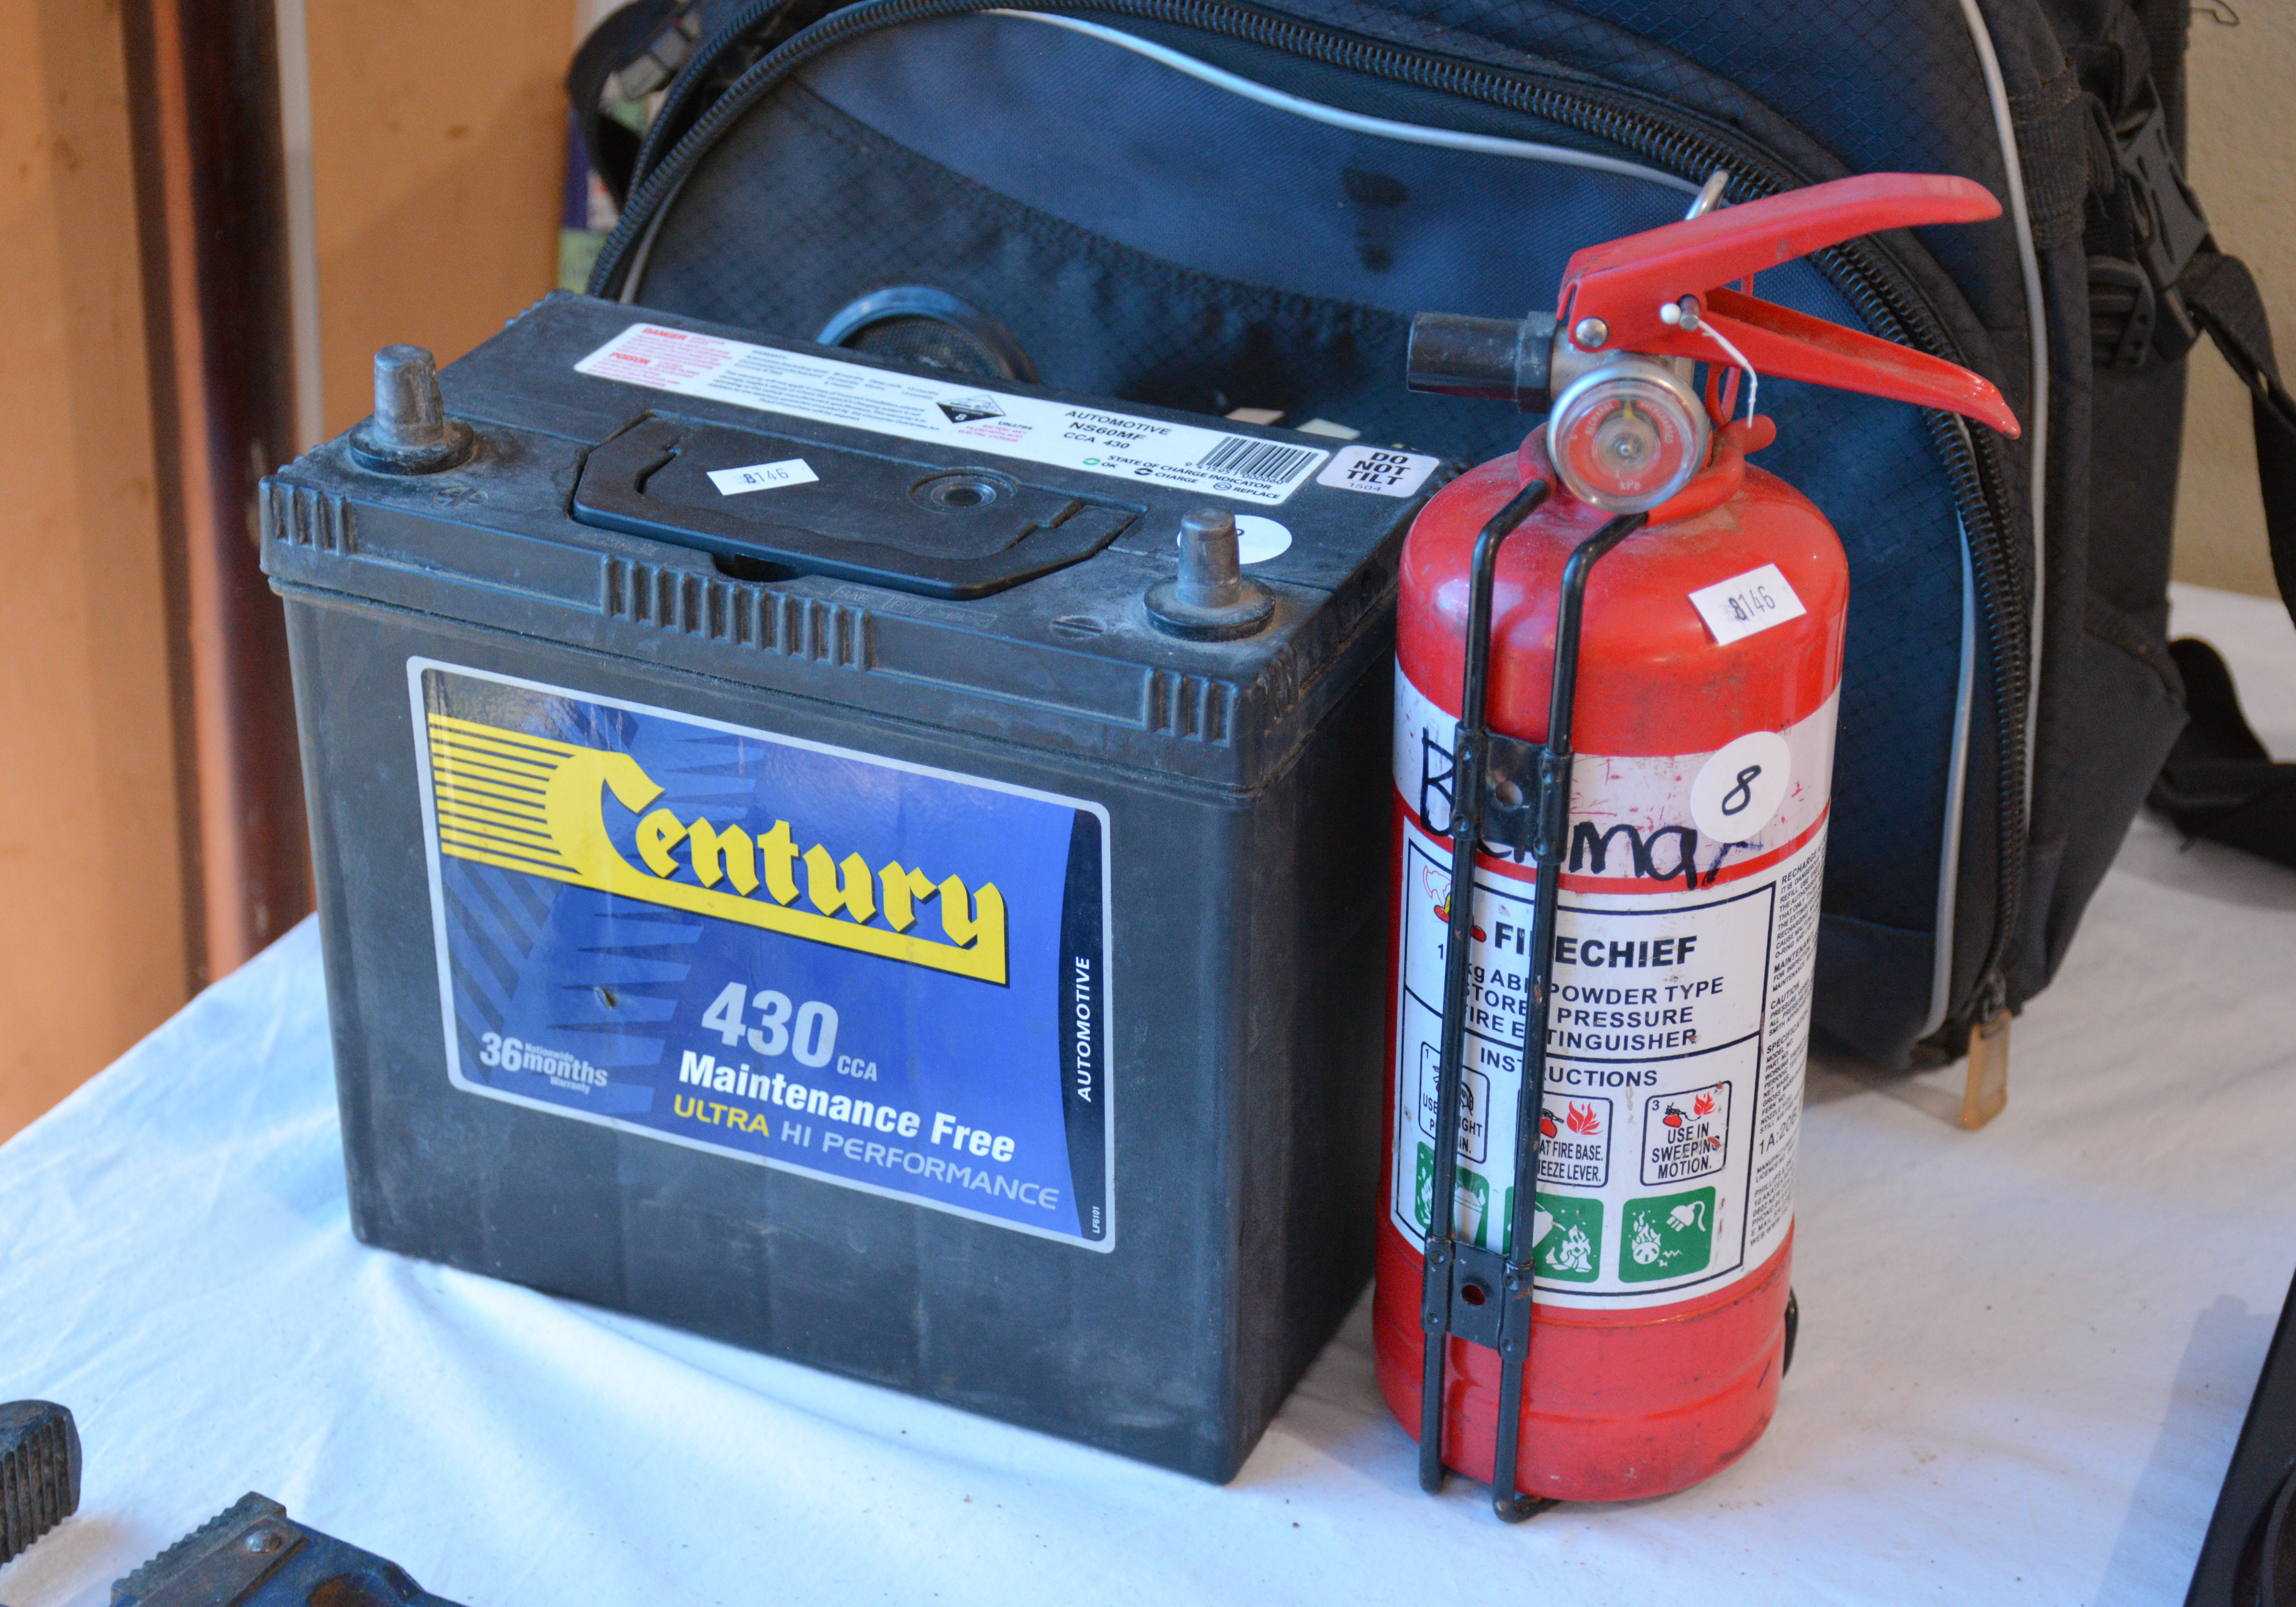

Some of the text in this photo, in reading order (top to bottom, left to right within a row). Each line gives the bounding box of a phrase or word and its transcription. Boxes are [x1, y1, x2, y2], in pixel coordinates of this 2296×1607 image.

[642, 327, 688, 340] DANGER
[1065, 411, 1172, 435] AUTOMOTIVE
[1069, 422, 1147, 440] NS60MF
[1064, 432, 1131, 449] CCA 430
[1354, 460, 1411, 475] NOT
[1370, 452, 1409, 464] DO
[1107, 455, 1143, 466] STATE
[1160, 465, 1208, 477] CHARGE
[1208, 474, 1272, 490] INDICATOR
[1155, 472, 1199, 483] CHARGE
[1347, 469, 1403, 485] TILT
[1233, 487, 1281, 499] REPLACE
[1349, 483, 1382, 492] 1504
[1620, 481, 1640, 490] kPa
[1721, 764, 1761, 816] 8
[544, 750, 1010, 988] Century
[1782, 849, 1816, 884] RECHARGE
[1781, 886, 1785, 894] IT
[1787, 881, 1792, 890] IS
[1800, 876, 1809, 889] USE
[1779, 900, 1790, 913] THE
[1779, 897, 1805, 922] THAT ONLY
[1778, 919, 1788, 931] THE
[1495, 921, 1697, 968] FIECHIEF
[1775, 940, 1794, 959] O-RING
[1776, 931, 1794, 950] CAUSE
[1773, 970, 1785, 982] FOR
[1665, 976, 1724, 1003] TYPE
[1771, 980, 1799, 1010] CAUTION
[1770, 993, 1796, 1020] PRESSURE
[1557, 1006, 1693, 1028] PRESSURE
[1769, 1017, 1779, 1028] ALL
[701, 980, 878, 1084] 430 CCA
[1076, 956, 1091, 1102] AUTOMOTIVE
[1466, 1004, 1697, 1051] IRE ETINGUISHER
[1768, 1020, 1785, 1037] SMITH
[480, 1031, 523, 1072] 36
[524, 1042, 575, 1062] Nationwide
[1766, 1046, 1783, 1064] MODEL
[523, 1052, 608, 1087] months
[1480, 1047, 1658, 1087] INSUCTIONS
[1765, 1057, 1779, 1072] PART
[1765, 1057, 1789, 1081] WORKING
[550, 1075, 590, 1094] Warranty
[1764, 1066, 1788, 1090] PERIODIC
[1762, 1089, 1781, 1107] GROSS
[1763, 1086, 1774, 1099] NET
[679, 1050, 1016, 1163] Maintenance Free
[1652, 1100, 1660, 1111] 3
[1761, 1101, 1775, 1116] FERN
[1761, 1105, 1781, 1126] NOZZLE
[1667, 1122, 1709, 1144] USE IN
[1760, 1119, 1774, 1134] STILL
[673, 1093, 1061, 1210] ULTRA HI PERFORMANCE
[1552, 1141, 1573, 1159] FIRE
[1575, 1144, 1603, 1161] BASE.
[1652, 1135, 1720, 1163] SWEEPING
[1567, 1164, 1601, 1182] LEVER.
[1658, 1155, 1712, 1179] MOTION.
[1092, 1206, 1101, 1234] LF6101
